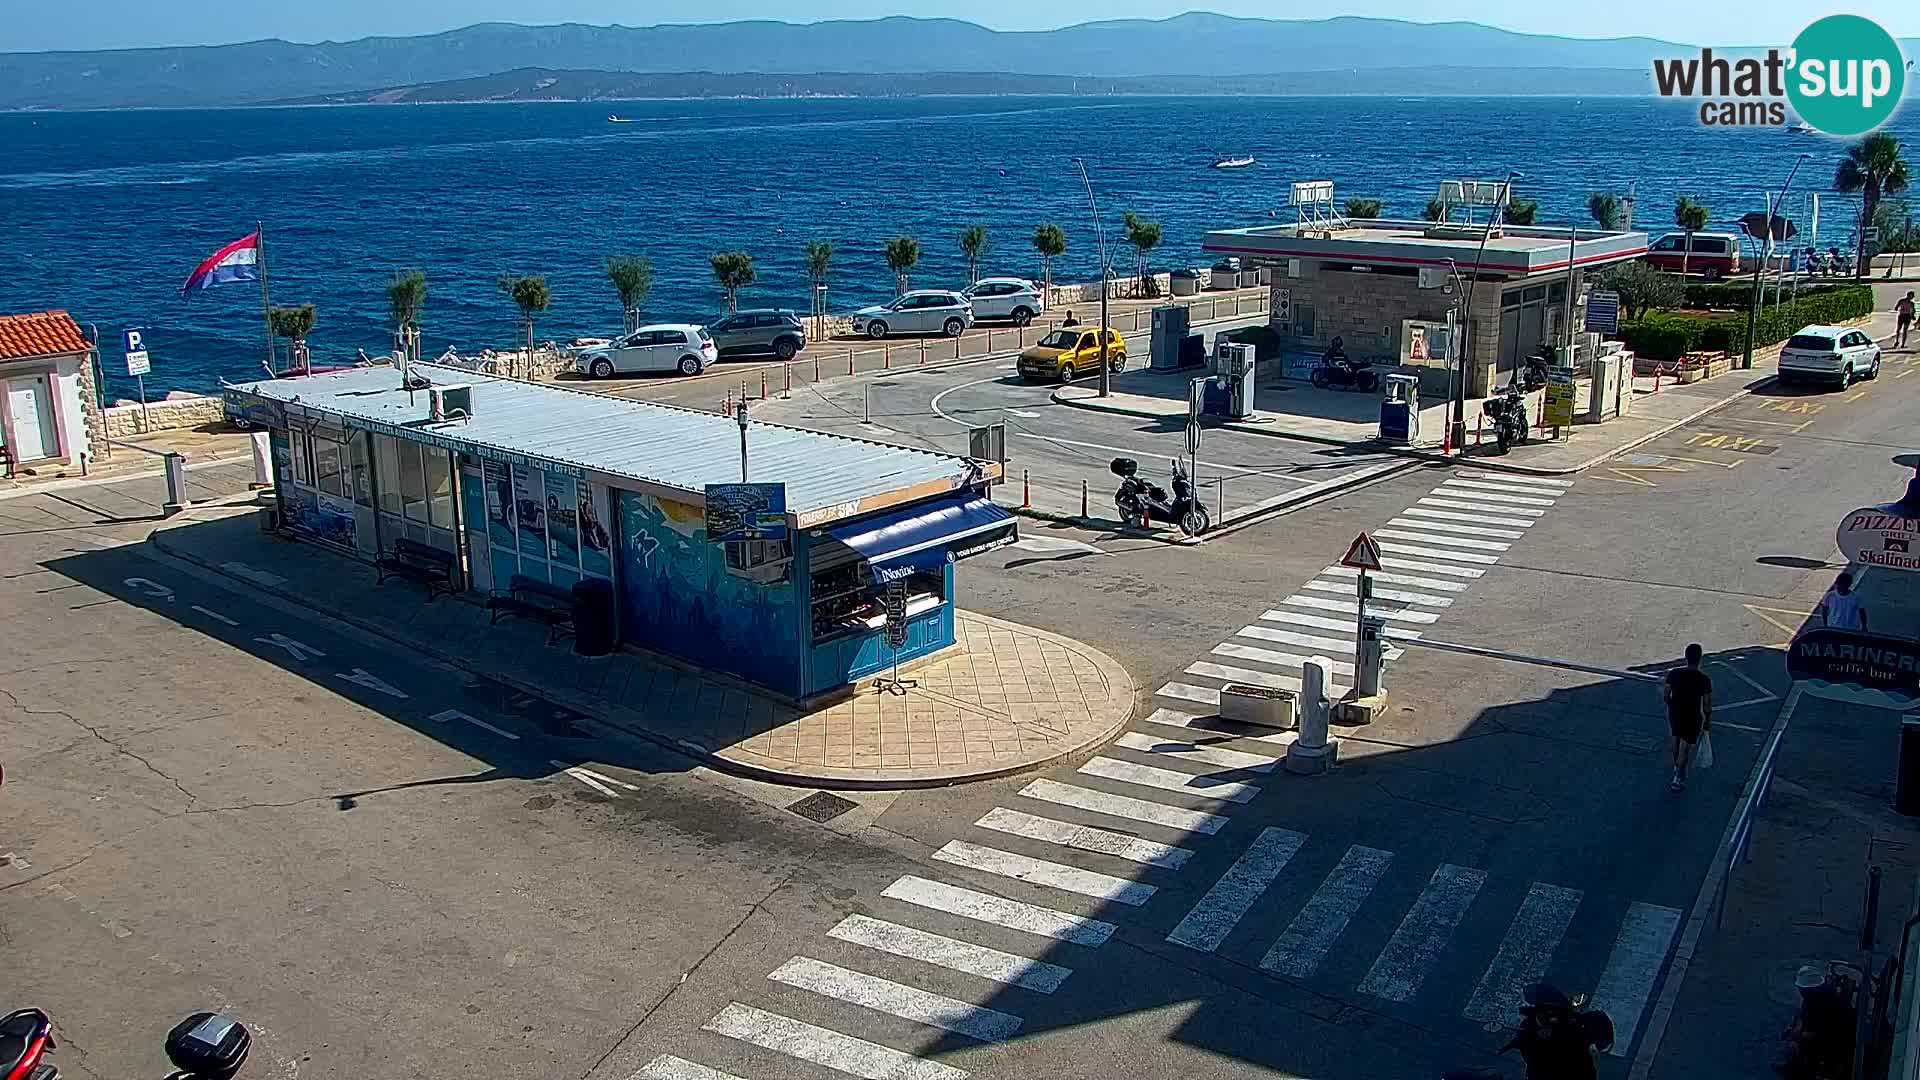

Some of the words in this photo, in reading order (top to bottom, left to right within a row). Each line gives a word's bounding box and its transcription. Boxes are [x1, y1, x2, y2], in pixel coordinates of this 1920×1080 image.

[128, 332, 142, 350] P
[1757, 398, 1827, 415] TAXI
[1684, 432, 1764, 452] TAXI
[436, 437, 467, 453] POSTAJA
[477, 445, 491, 458] BUS
[493, 449, 525, 465] STATION
[527, 456, 553, 471] TICKET
[554, 463, 581, 478] OFFICE
[1848, 515, 1920, 534] PIZZE
